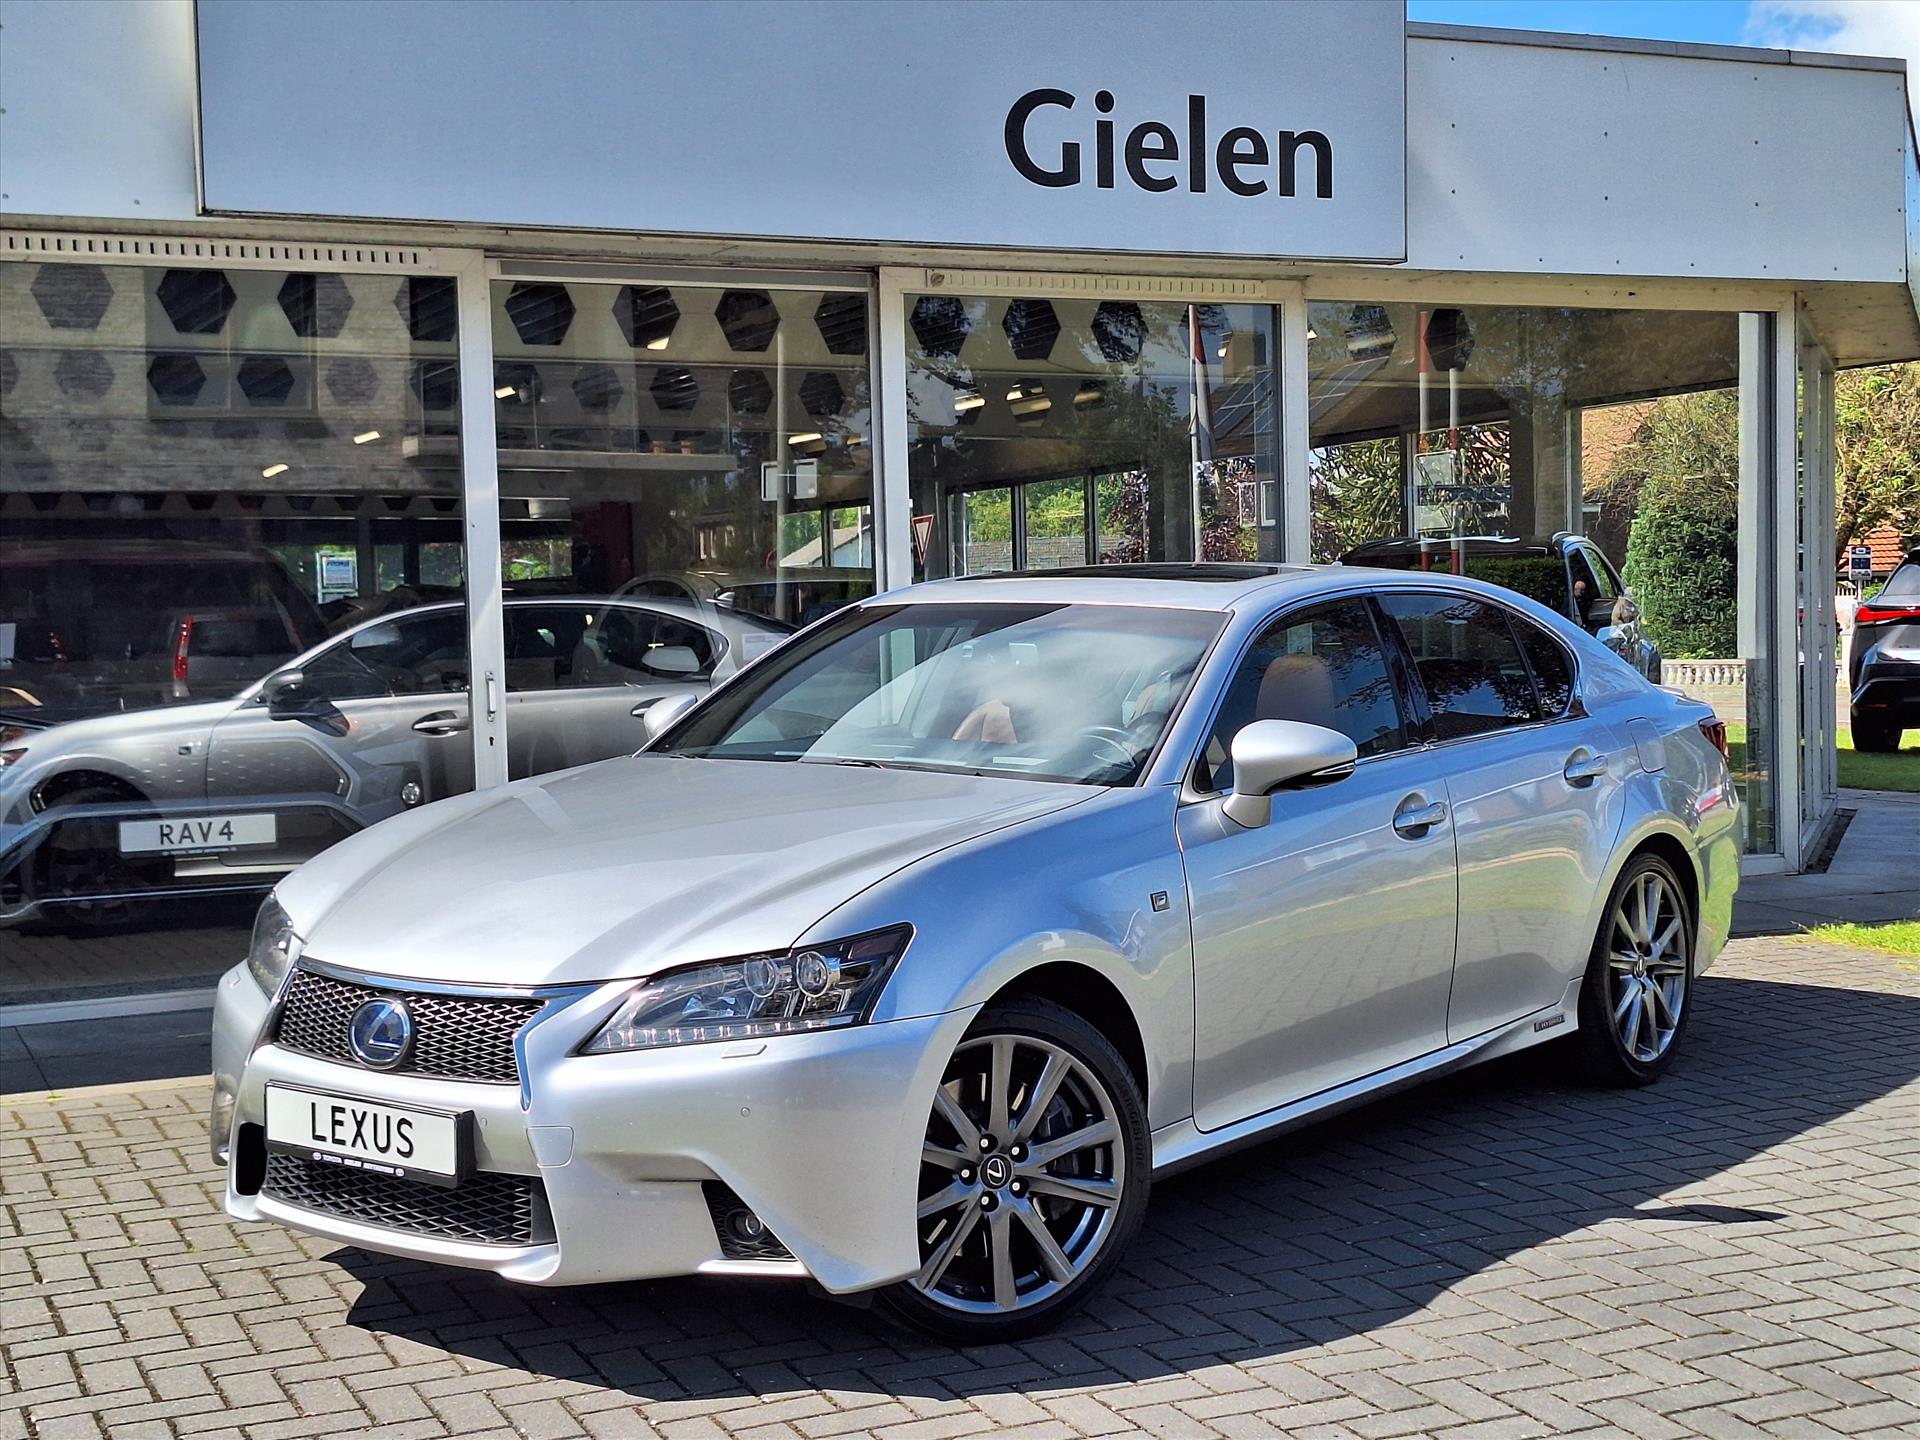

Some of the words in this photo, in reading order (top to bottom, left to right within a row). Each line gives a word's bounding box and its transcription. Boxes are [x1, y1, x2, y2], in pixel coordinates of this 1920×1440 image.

[1004, 88, 1333, 199] Gielen
[159, 820, 235, 846] RAV4
[311, 1102, 414, 1159] LEXUS
